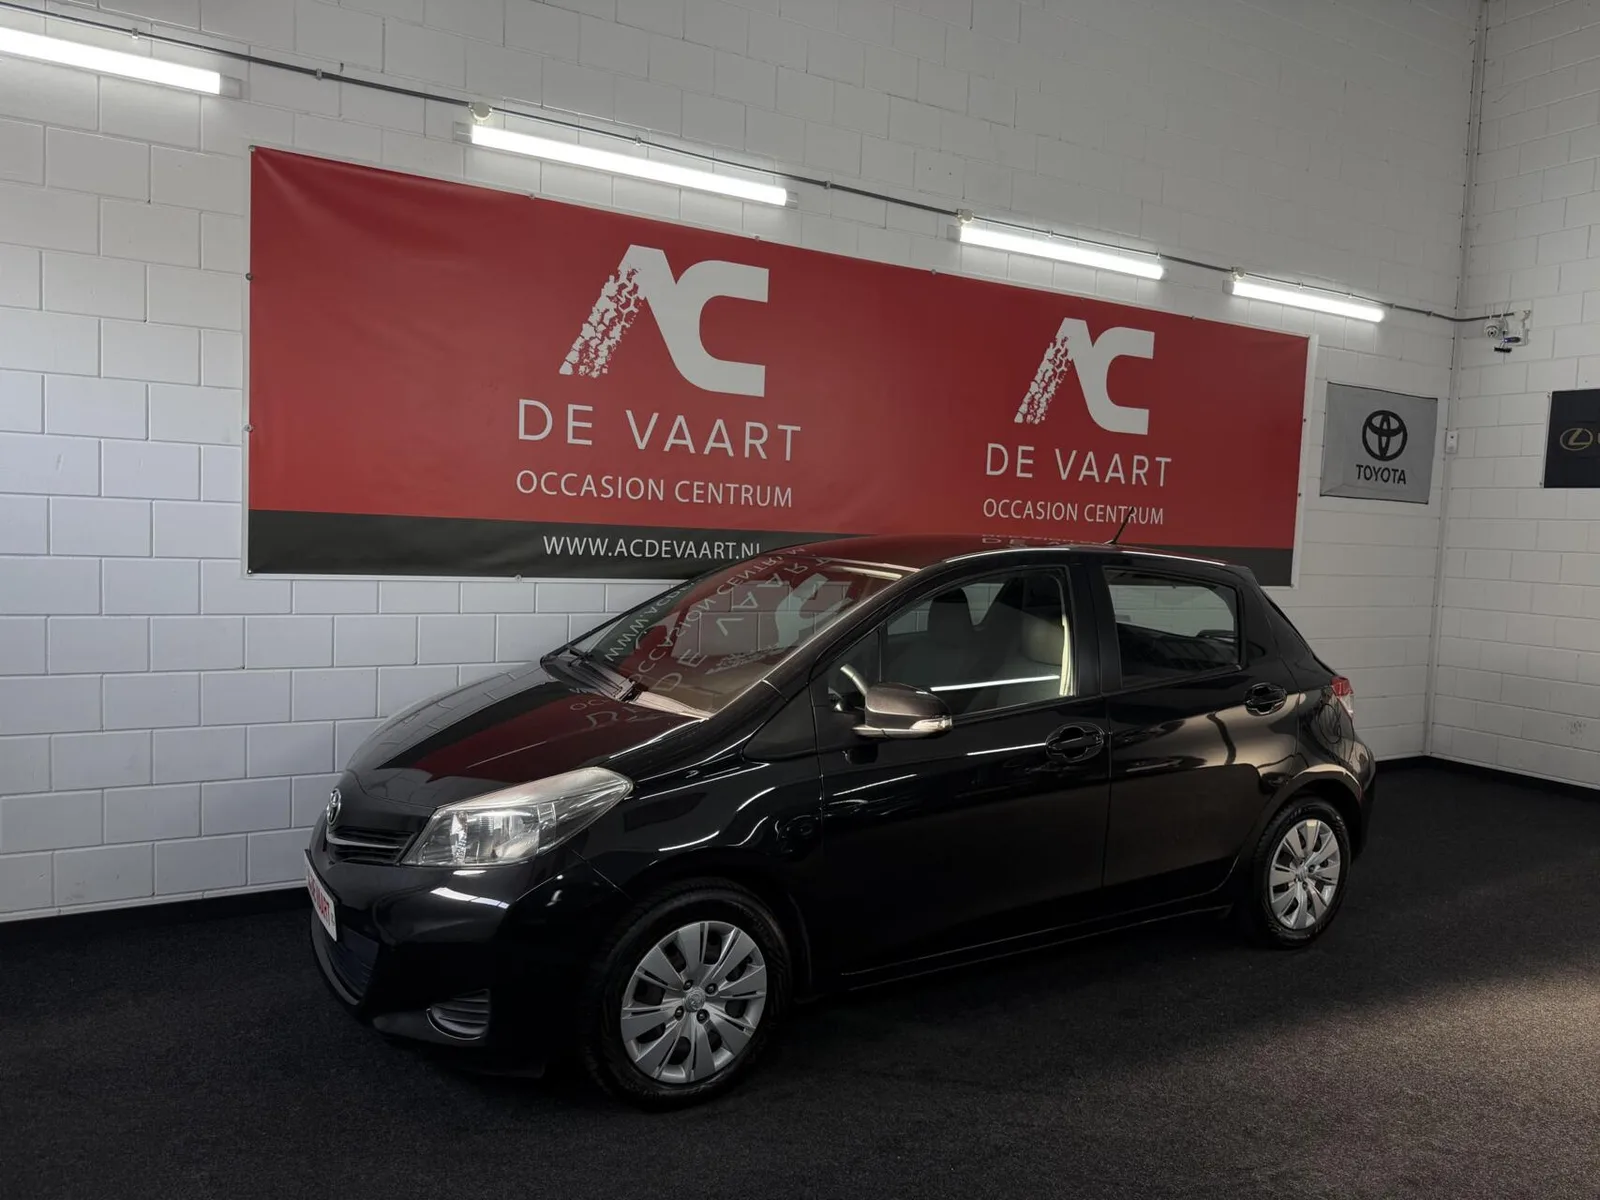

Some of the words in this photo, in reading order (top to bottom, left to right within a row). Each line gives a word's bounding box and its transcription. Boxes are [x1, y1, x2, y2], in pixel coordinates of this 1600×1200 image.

[559, 244, 769, 398] AC
[1013, 317, 1155, 435] AC
[518, 398, 593, 445] DE
[625, 409, 801, 461] VAART
[986, 443, 1035, 478] DE
[1055, 448, 1172, 487] VAART
[1355, 463, 1407, 485] TOYOTA
[516, 470, 664, 501] OCCASION
[674, 480, 793, 508] CENTRUM
[983, 498, 1078, 522] OCCASION
[1084, 503, 1164, 525] CENTRUM
